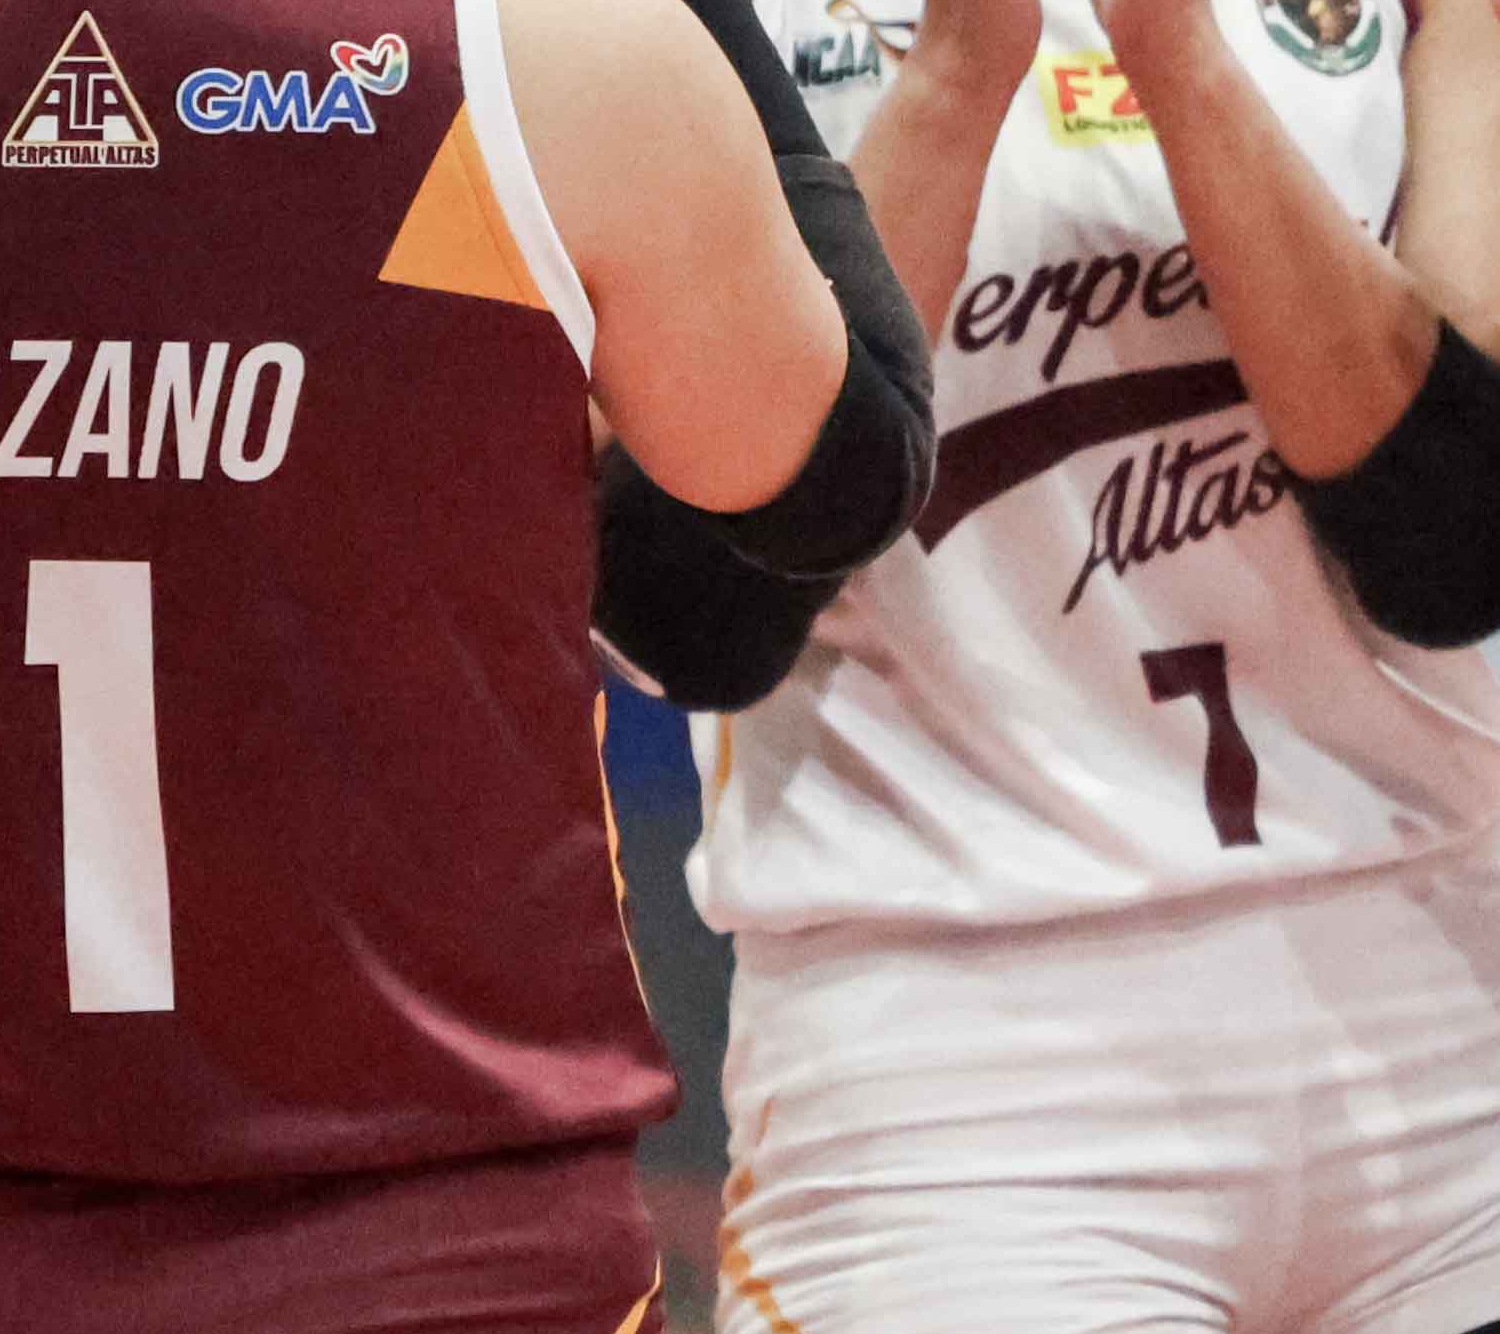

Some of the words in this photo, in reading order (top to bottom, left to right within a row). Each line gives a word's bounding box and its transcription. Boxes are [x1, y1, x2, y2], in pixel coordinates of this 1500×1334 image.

[5, 145, 102, 165] PERPETUAL
[105, 145, 156, 165] ALTAS
[178, 68, 375, 134] GMA
[1062, 431, 1297, 616] Altas
[24, 559, 175, 1014] 1
[1140, 642, 1263, 849] 7
